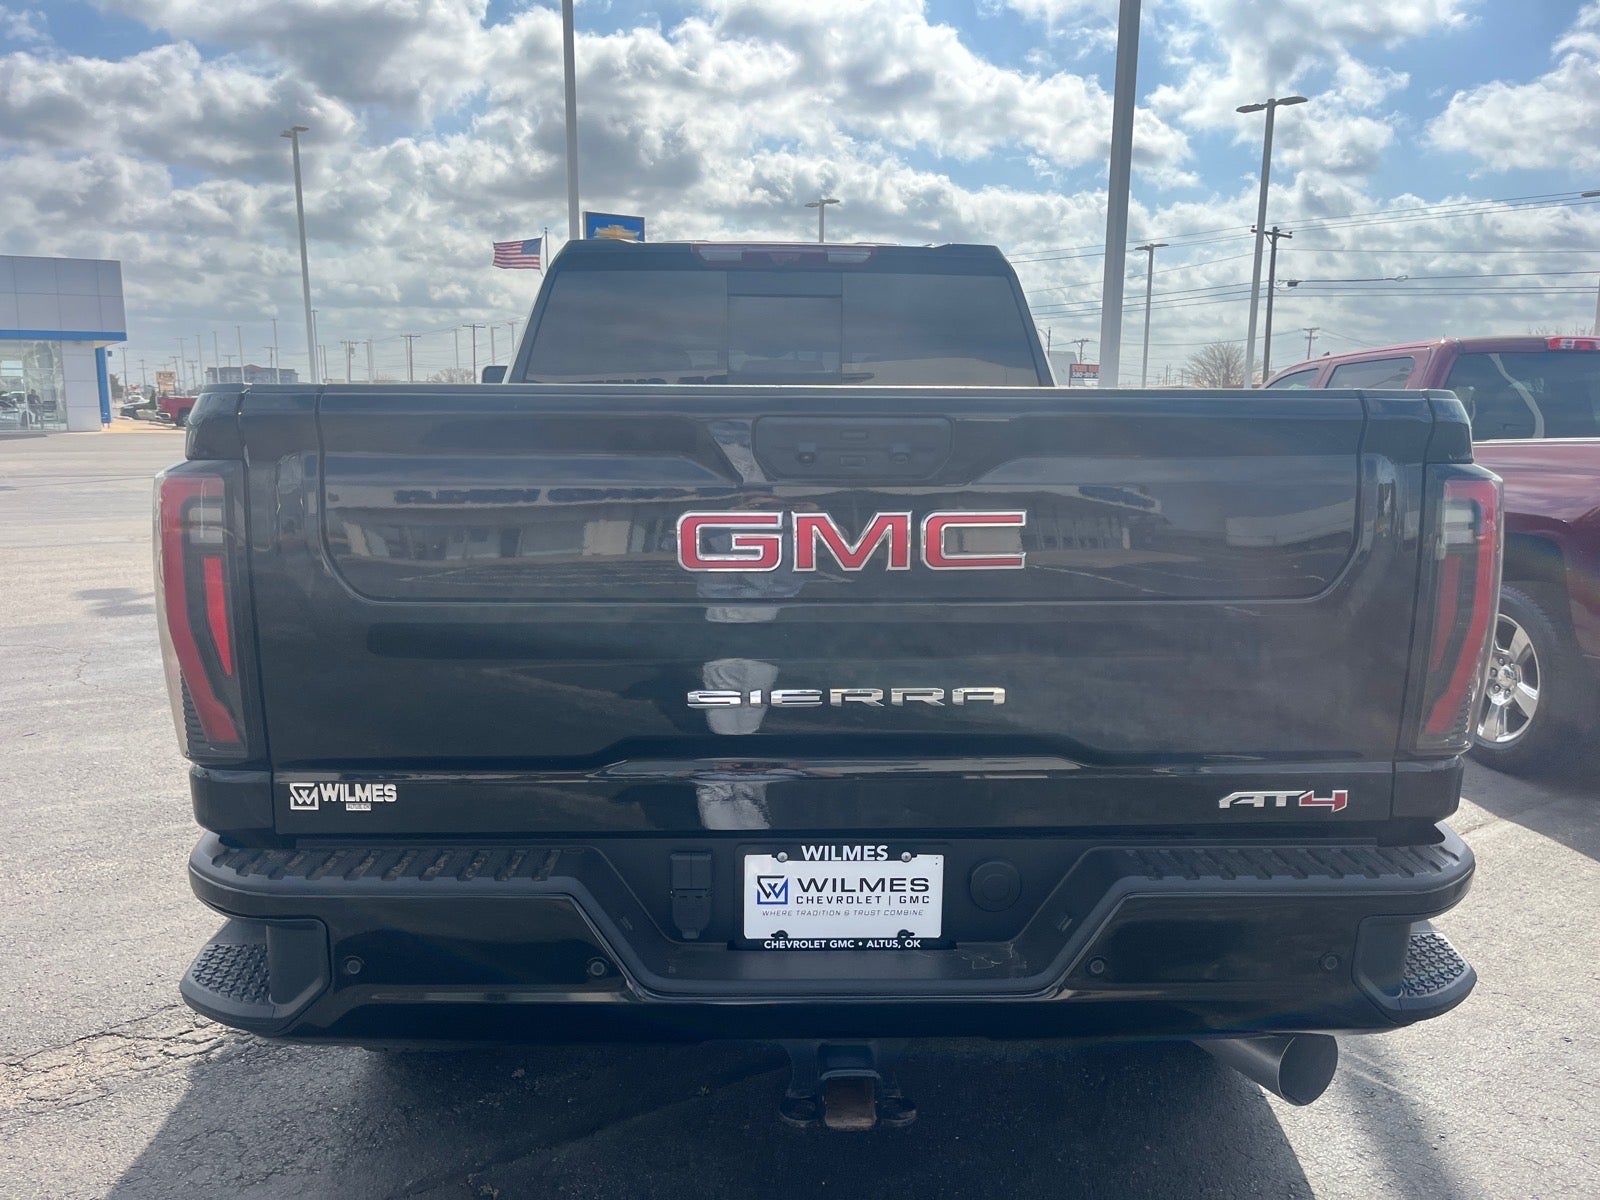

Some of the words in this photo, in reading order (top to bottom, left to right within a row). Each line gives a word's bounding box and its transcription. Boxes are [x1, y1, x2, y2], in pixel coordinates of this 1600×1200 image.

[676, 510, 1027, 572] GMC
[687, 687, 1006, 708] SIERRA
[319, 783, 398, 802] WILMES
[1218, 789, 1349, 813] AT4
[801, 845, 889, 861] WILMES
[797, 877, 930, 893] WILMES
[796, 895, 882, 905] CHEVROLET
[899, 895, 930, 904] GMC
[763, 940, 827, 949] CHEVROLET
[829, 939, 855, 949] GMC
[866, 939, 901, 949] ALTUS,
[904, 939, 921, 948] OK
